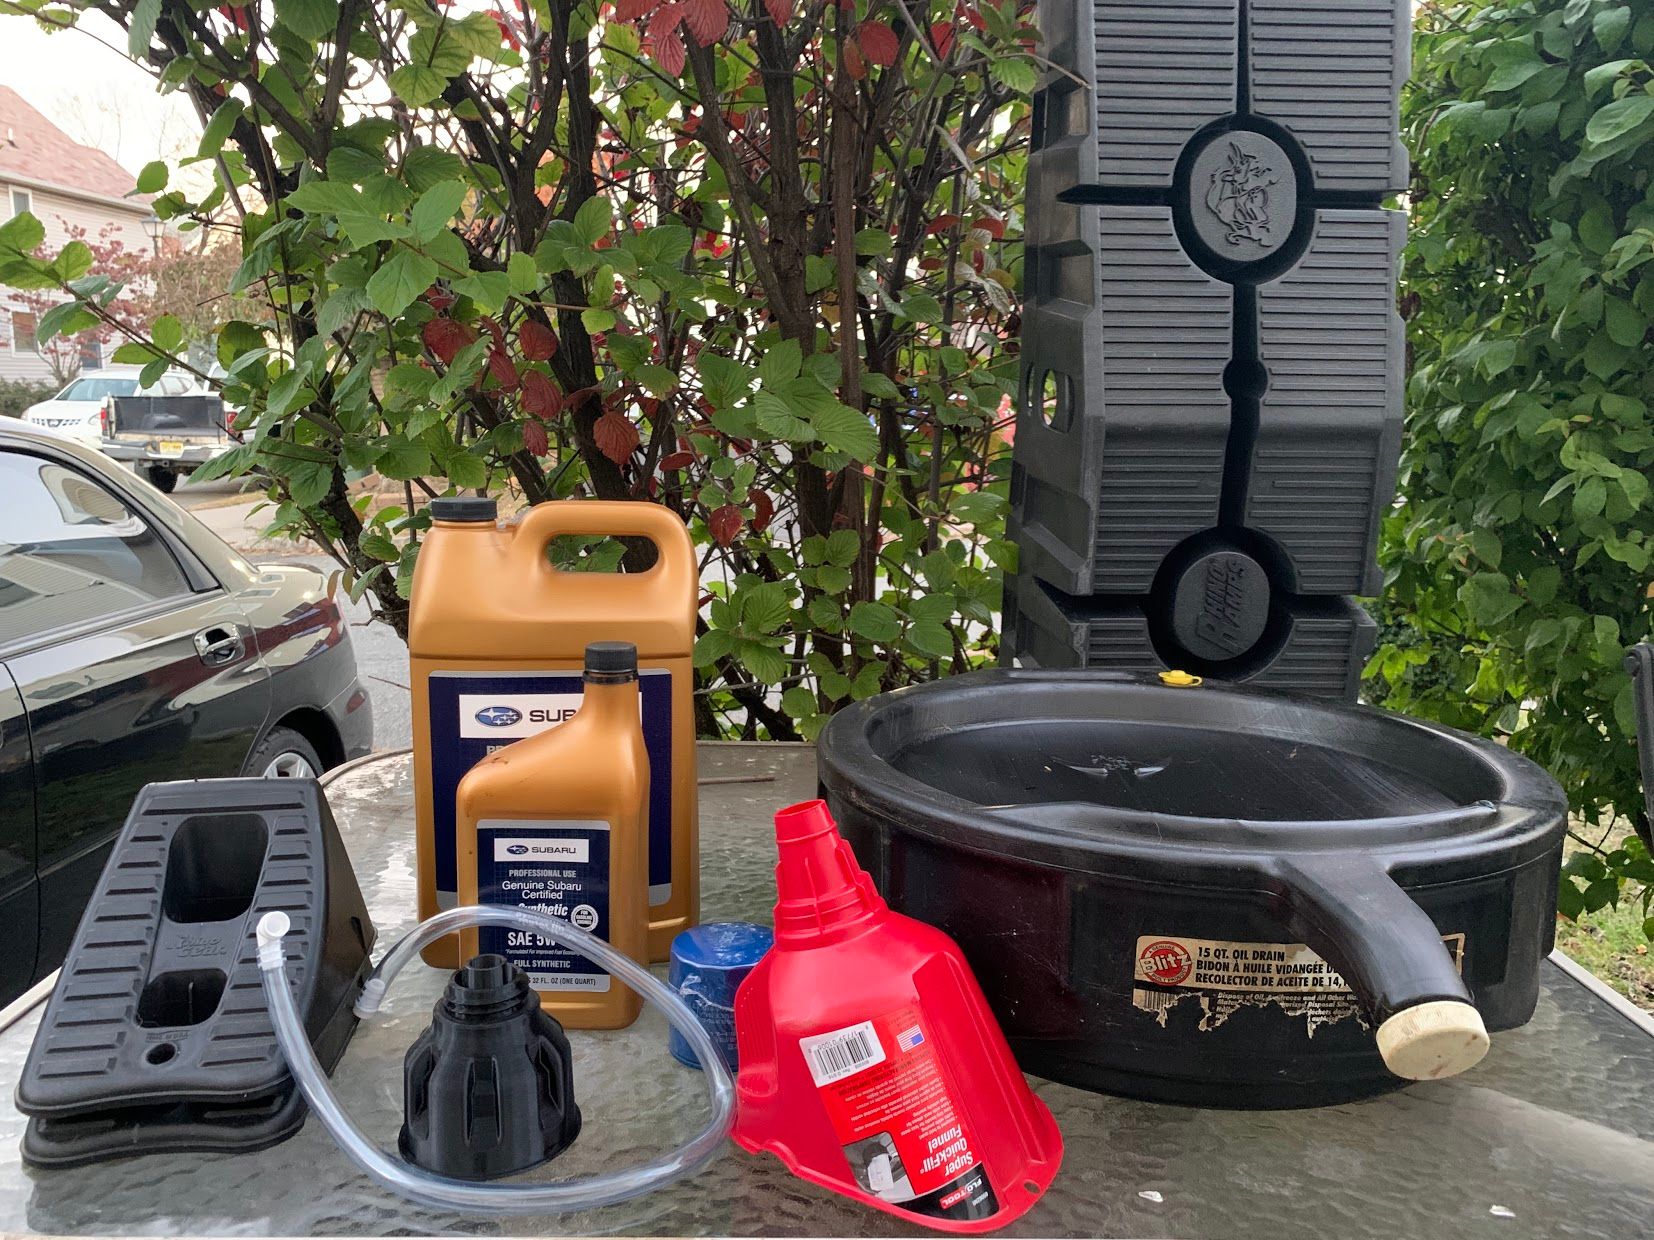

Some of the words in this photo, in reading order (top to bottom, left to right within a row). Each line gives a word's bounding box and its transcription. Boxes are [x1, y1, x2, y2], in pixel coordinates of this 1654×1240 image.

[531, 846, 577, 854] SUBARU
[508, 869, 561, 877] PROFESSIONAL
[563, 870, 577, 878] USE
[502, 880, 544, 890] Genuine
[547, 880, 582, 891] Subaru
[521, 889, 563, 900] Certified
[507, 931, 533, 946] SAE
[1198, 946, 1211, 958] 15
[1213, 948, 1229, 960] QT.
[1232, 949, 1249, 961] OIL
[1252, 950, 1285, 962] DRAIN
[513, 959, 531, 968] FULL
[531, 960, 571, 969] SYNTHETIC
[1139, 953, 1192, 974] Blitz
[1196, 960, 1230, 972] BIDON
[1243, 963, 1272, 974] HUILE
[1275, 961, 1324, 975] VIDANGÉE
[574, 978, 596, 986] QUART)
[1195, 972, 1258, 986] RECOLECTOR
[1261, 976, 1274, 986] DE
[1276, 976, 1309, 987] ACEITE
[1311, 976, 1324, 987] DE
[927, 1123, 963, 1154] Funnel
[944, 1151, 973, 1177] Super
